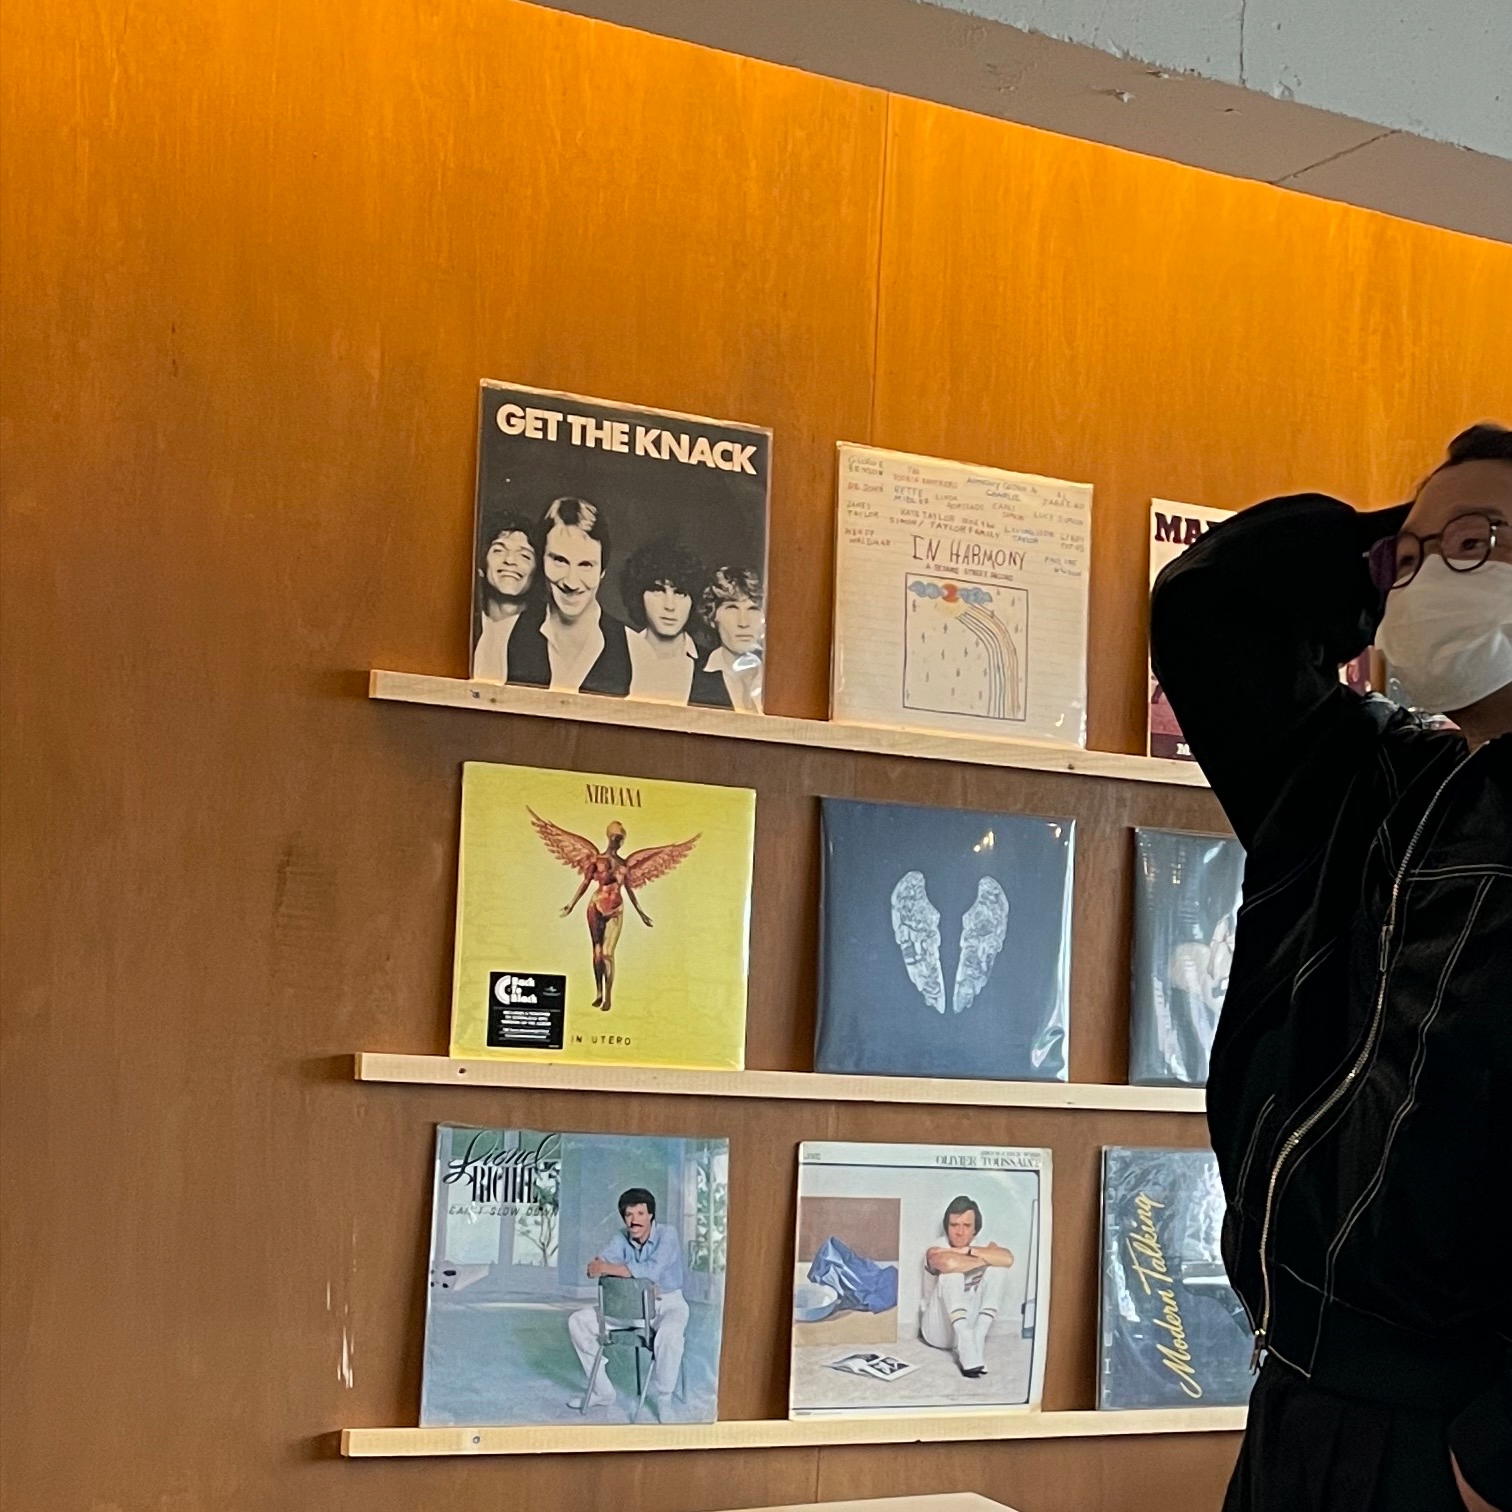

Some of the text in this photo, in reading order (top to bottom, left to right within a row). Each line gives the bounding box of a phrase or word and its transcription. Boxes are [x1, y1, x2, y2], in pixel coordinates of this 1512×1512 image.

[496, 403, 757, 475] GET THE KNACK
[911, 533, 1026, 570] IN HARMONY
[585, 783, 642, 808] NIRVANA
[570, 1034, 632, 1046] IN UTERO
[442, 1130, 560, 1186] Lionel
[489, 1206, 520, 1216] SLOW
[1126, 1191, 1203, 1399] Modern Talking
